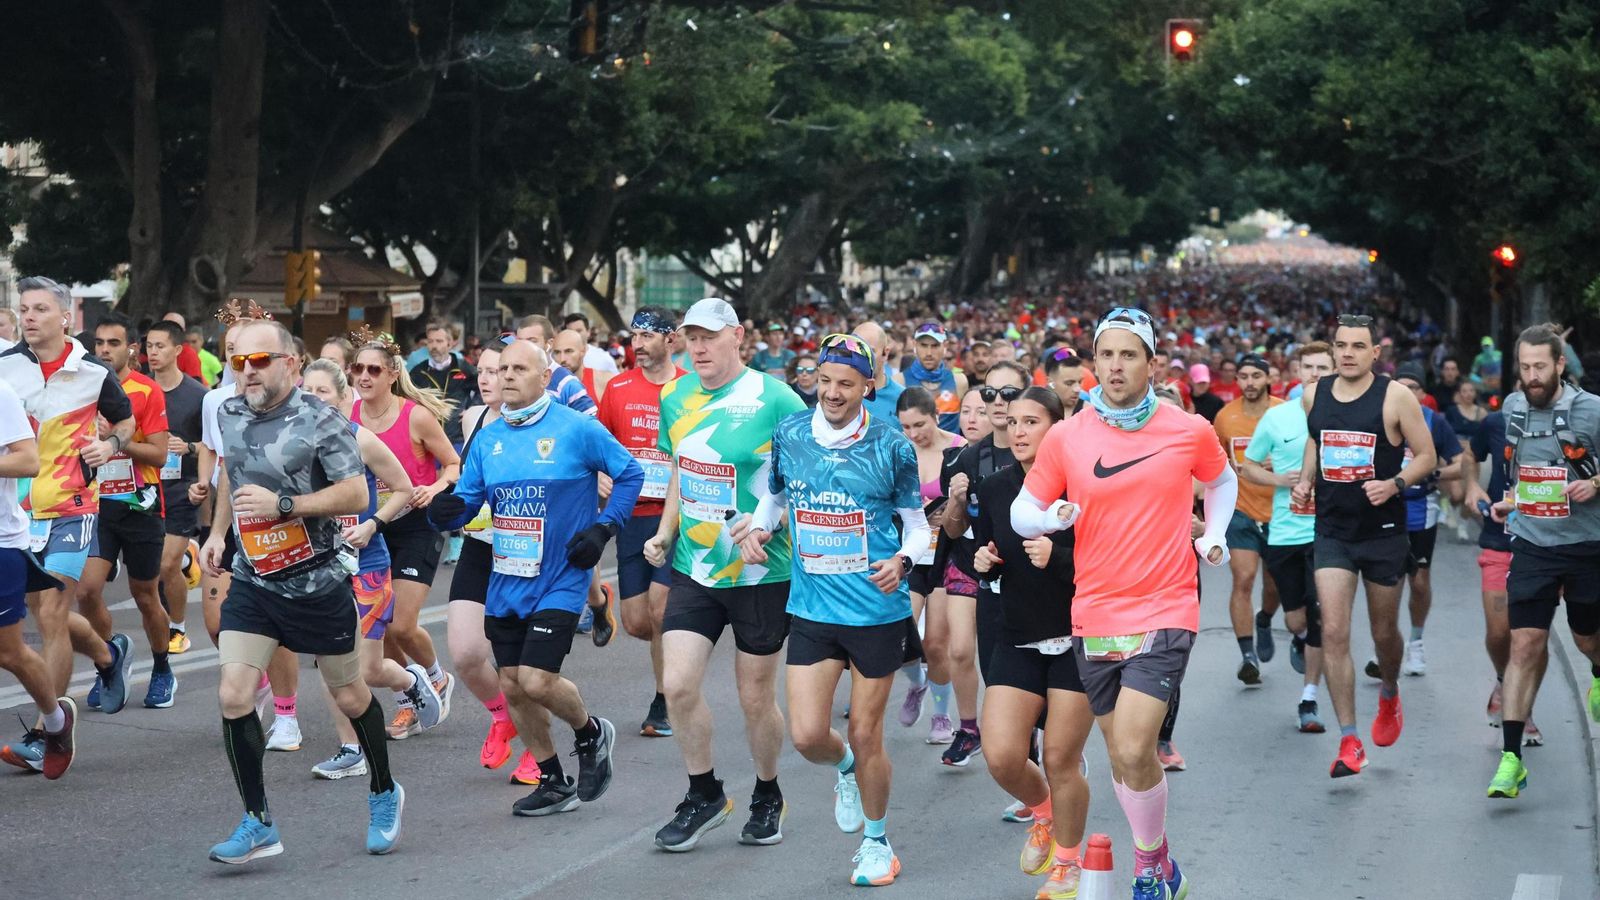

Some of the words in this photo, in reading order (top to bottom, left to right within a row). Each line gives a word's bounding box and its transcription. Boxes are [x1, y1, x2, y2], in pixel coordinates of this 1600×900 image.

[1335, 433, 1372, 444] GENERALI
[691, 461, 730, 476] GENERALI
[494, 486, 523, 501] ORO
[526, 485, 546, 499] DE
[687, 479, 721, 497] 16266
[1526, 485, 1553, 496] 6609
[810, 490, 857, 507] MEDIA
[499, 519, 538, 531] GENERALI
[812, 514, 859, 526] GENERALI
[253, 530, 288, 547] 7420
[498, 537, 529, 550] 12766
[809, 534, 850, 547] 16007
